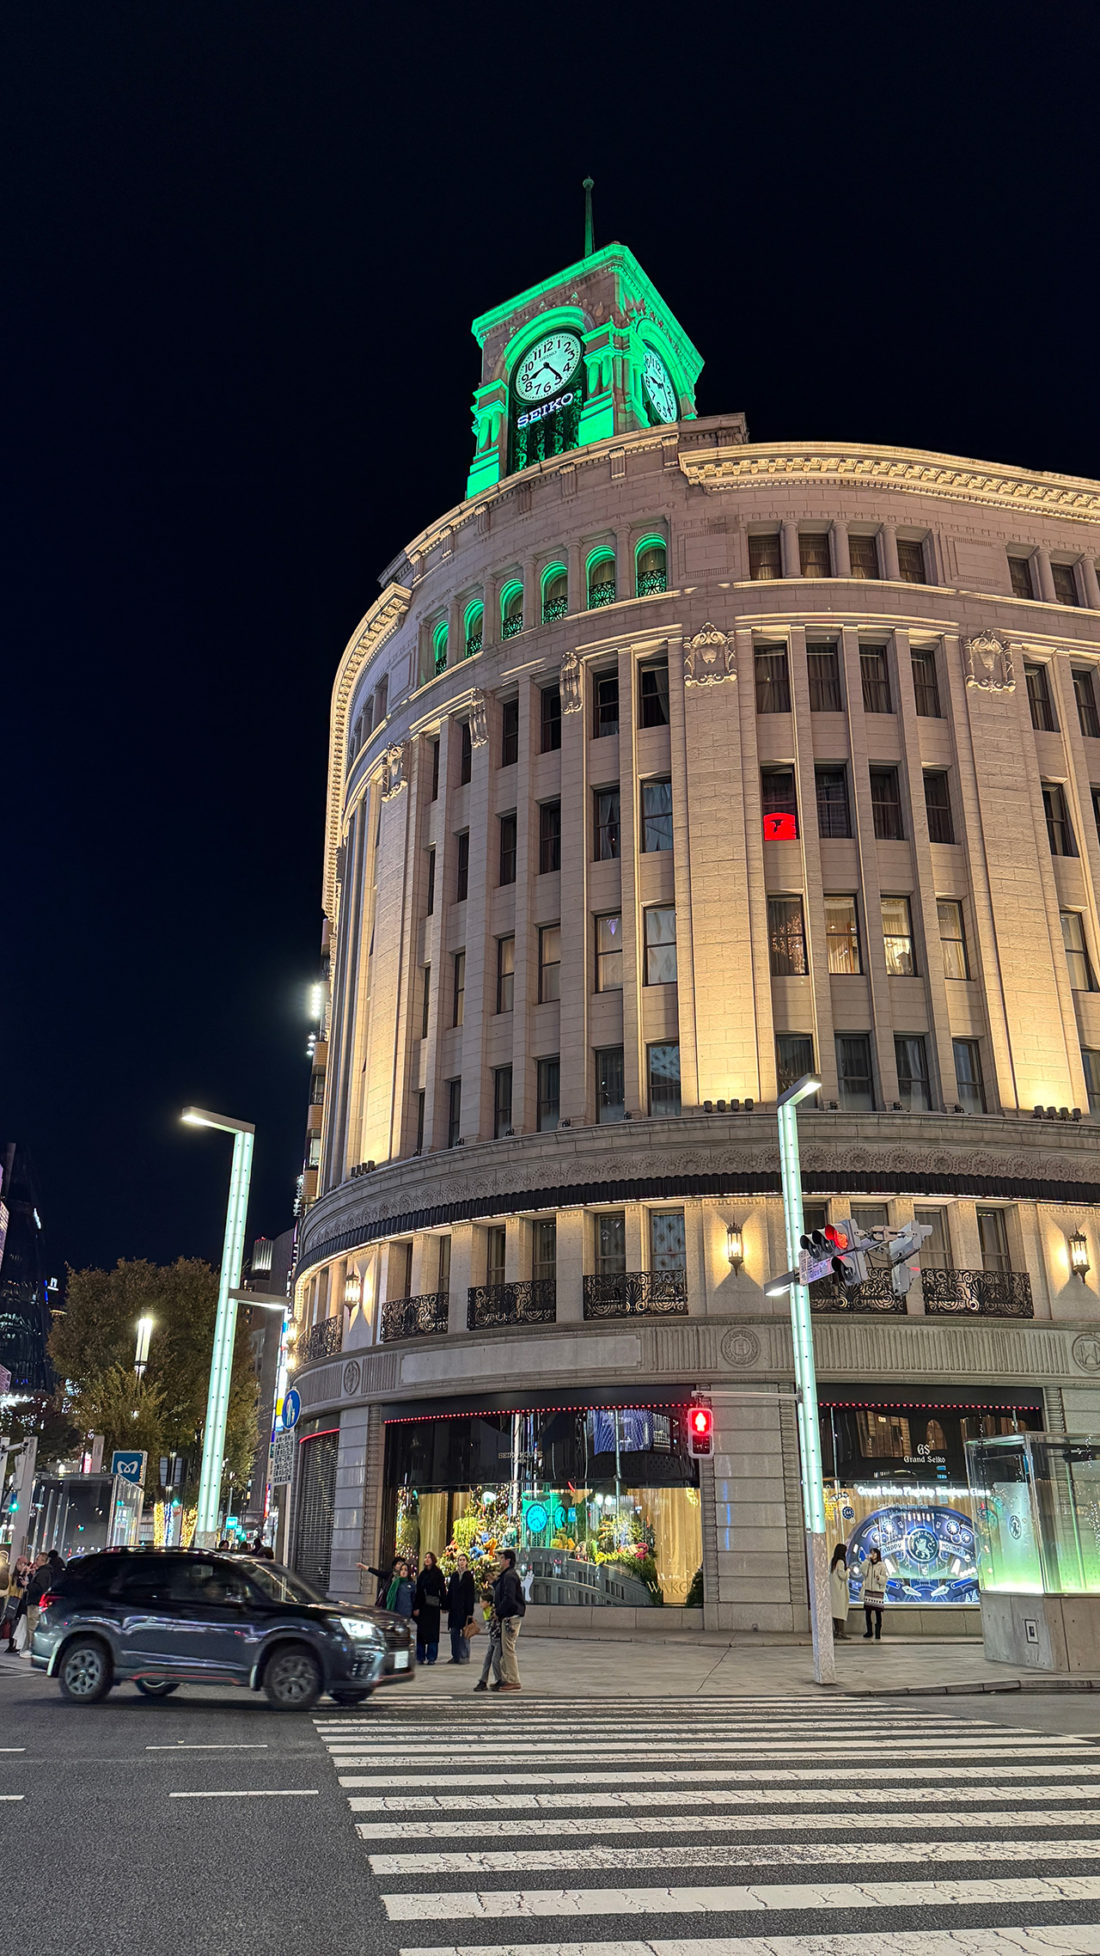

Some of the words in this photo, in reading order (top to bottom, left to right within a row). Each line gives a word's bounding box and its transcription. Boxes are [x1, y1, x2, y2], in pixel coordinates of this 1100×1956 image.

[543, 341, 553, 353] 12
[563, 341, 571, 353] 2
[533, 348, 541, 361] 11
[567, 349, 575, 361] 3
[525, 361, 534, 373] 10
[563, 362, 571, 372] 4
[521, 374, 529, 385] 9
[525, 381, 533, 393] 8
[534, 384, 542, 395] 7
[543, 382, 552, 393] 6
[517, 393, 573, 429] SEIKO
[917, 1443, 930, 1455] GS
[903, 1455, 926, 1463] Grand
[927, 1455, 946, 1463] Seiko
